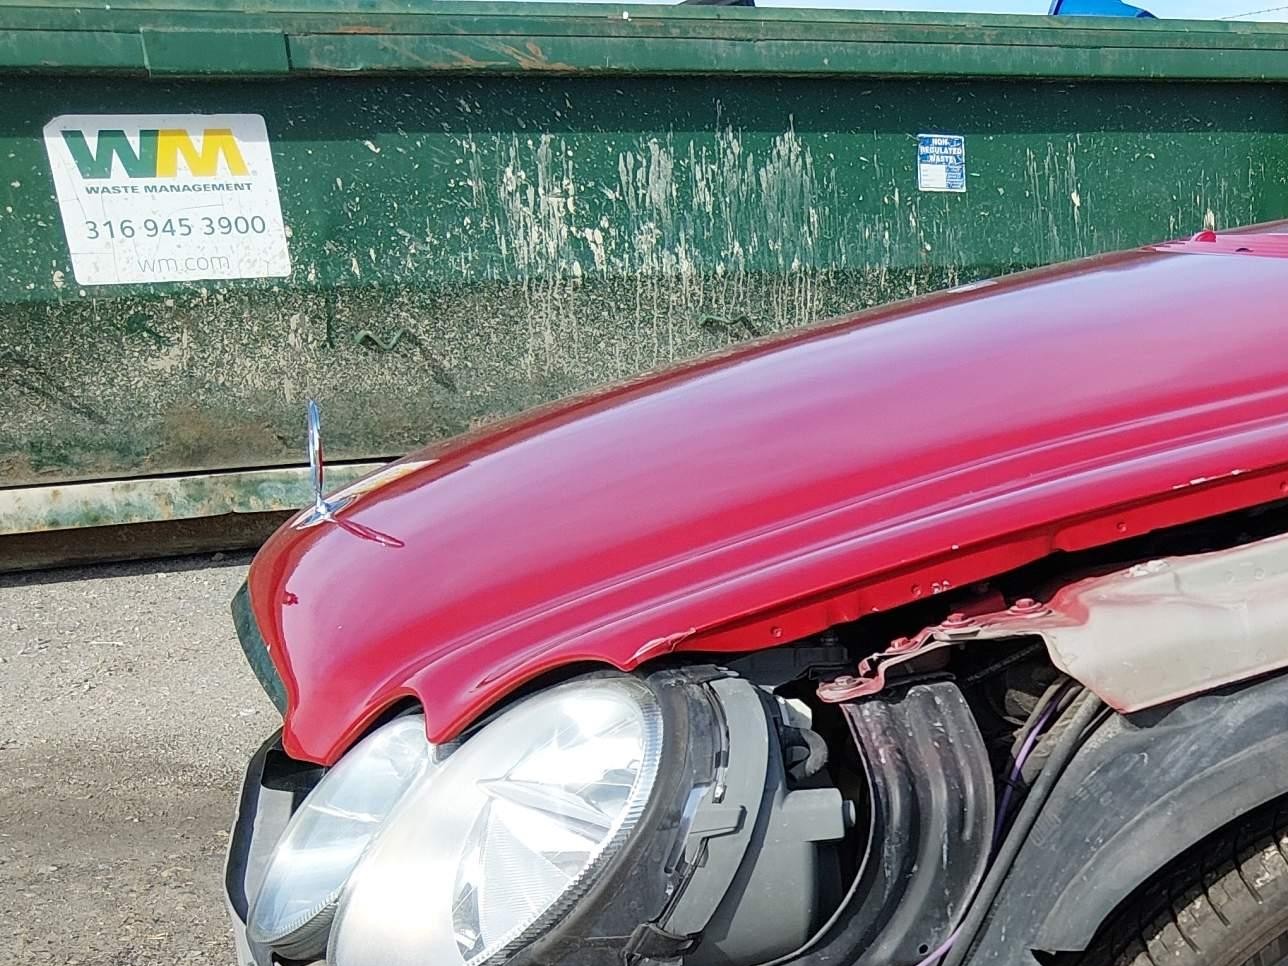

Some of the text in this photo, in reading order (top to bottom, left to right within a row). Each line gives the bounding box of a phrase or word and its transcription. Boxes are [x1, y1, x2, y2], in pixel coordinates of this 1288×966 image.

[60, 128, 251, 180] WM
[85, 183, 253, 195] WASTE MANAGEMENT
[85, 215, 267, 240] 316 945 3900
[138, 255, 230, 273] wm.com
